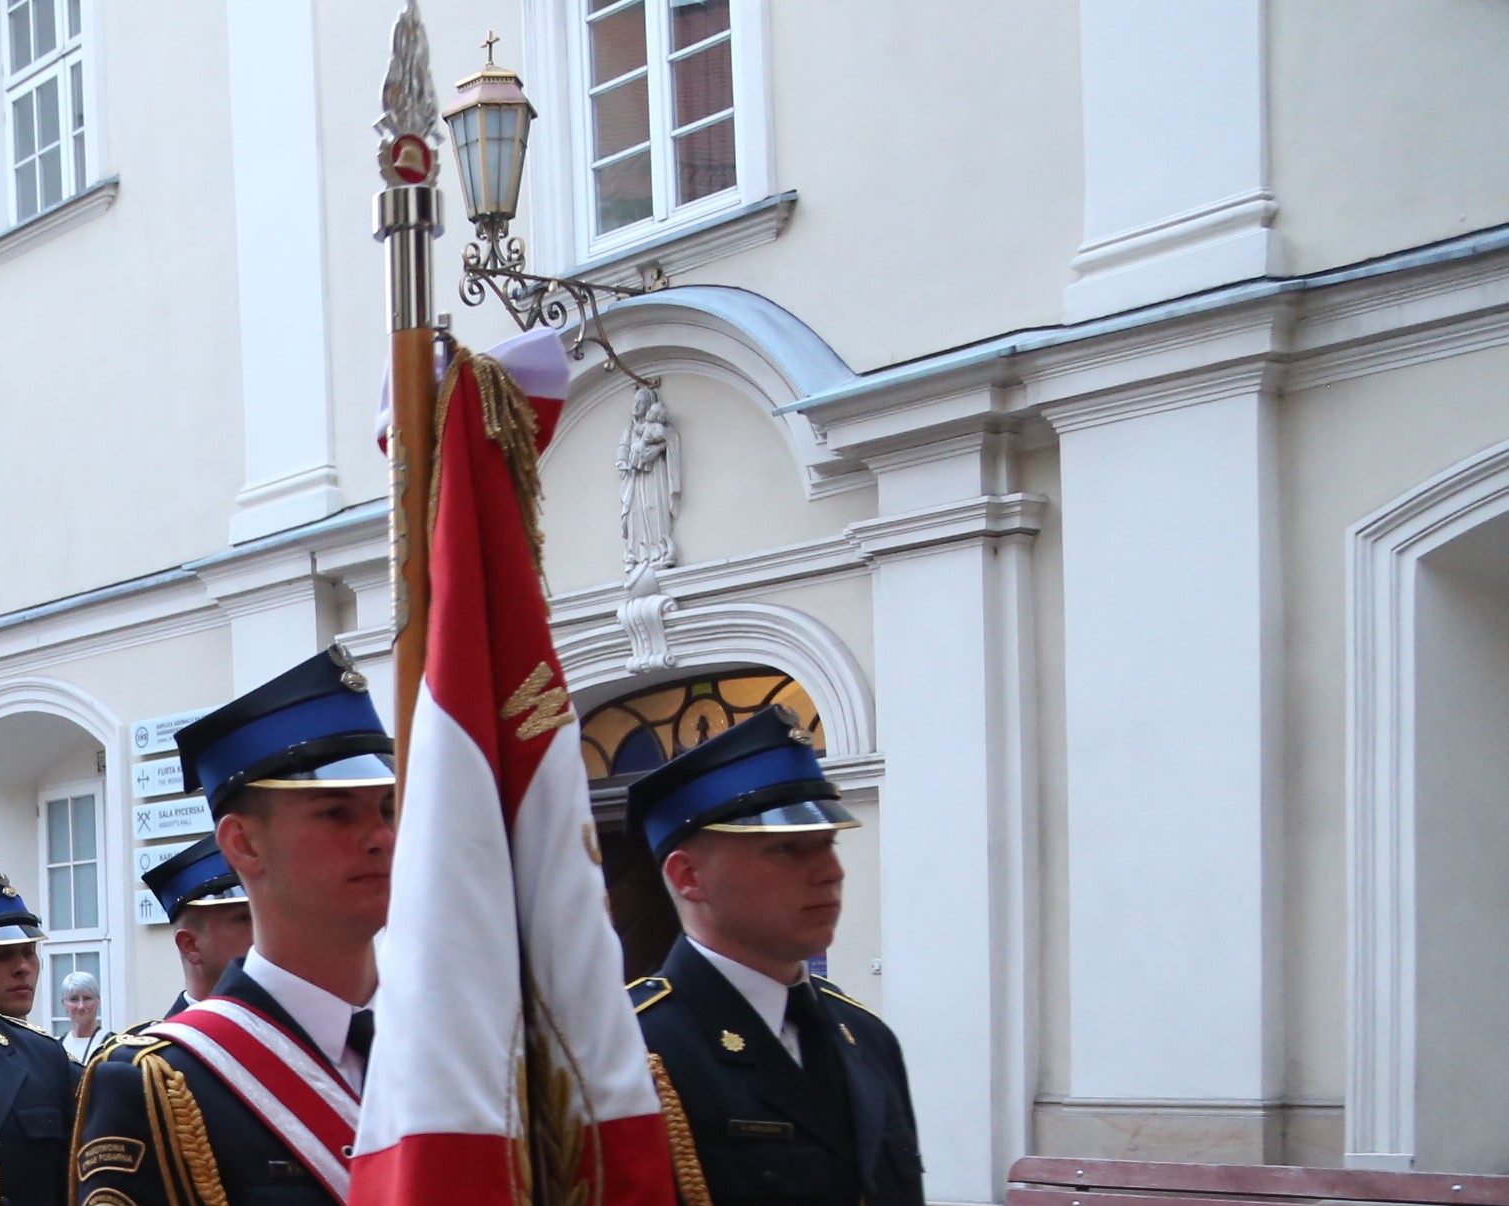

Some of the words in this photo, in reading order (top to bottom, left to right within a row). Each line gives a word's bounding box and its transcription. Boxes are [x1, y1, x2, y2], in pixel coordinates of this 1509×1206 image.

[158, 765, 176, 776] FURTA
[159, 809, 174, 819] SALA
[174, 805, 205, 816] RYCERSKA
